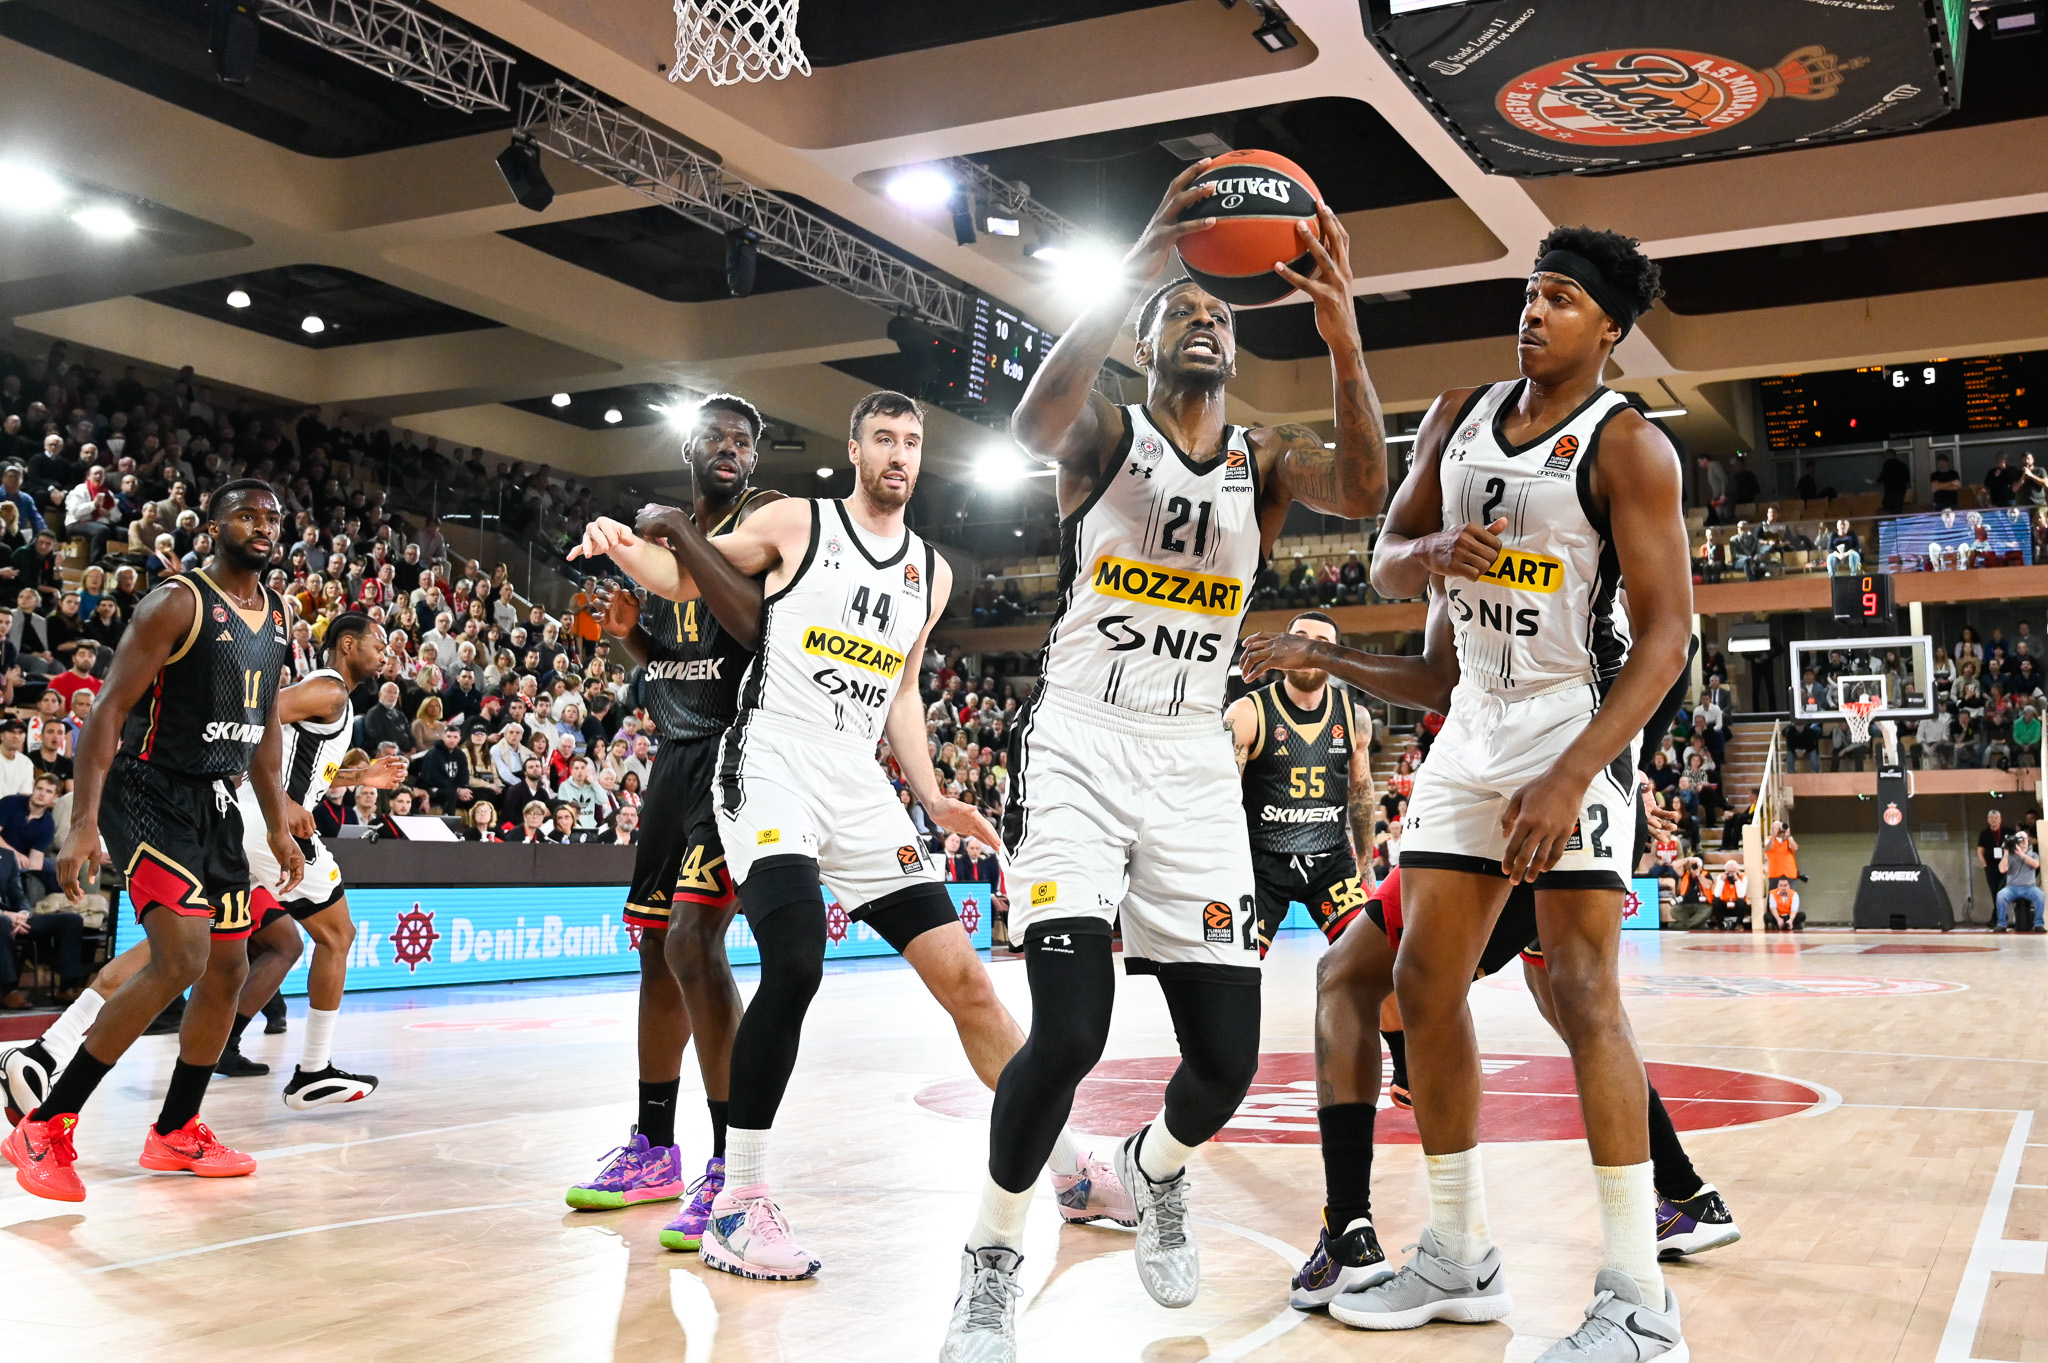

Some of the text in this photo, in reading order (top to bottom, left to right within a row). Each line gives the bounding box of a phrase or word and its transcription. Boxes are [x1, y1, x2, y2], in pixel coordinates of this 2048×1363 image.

[1447, 18, 1508, 62] Stade Louis II
[1498, 32, 1510, 41] DE
[1506, 8, 1535, 33] MONACO
[1505, 91, 1558, 132] BASKET
[1188, 177, 1291, 204] SPALDI
[995, 319, 1009, 340] 10
[1025, 335, 1033, 353] 4
[1003, 358, 1024, 381] 6:09
[1537, 469, 1570, 480] oneteam
[1482, 478, 1505, 526] 2
[1161, 496, 1213, 557] 21
[1095, 561, 1241, 611] MOZZART
[1862, 576, 1872, 592] 0
[673, 601, 699, 643] 14
[851, 585, 891, 633] 44
[1479, 599, 1540, 637] NIS
[1862, 593, 1877, 616] 9
[805, 630, 902, 675] MOZZART
[1152, 624, 1222, 663] NIS
[645, 657, 725, 682] SKWEEK
[244, 669, 262, 709] 11
[850, 679, 887, 708] NIS
[1289, 766, 1326, 799] 55
[1586, 803, 1613, 858] 2
[1032, 896, 1055, 905] MOZZART
[451, 913, 620, 964] DenizBank
